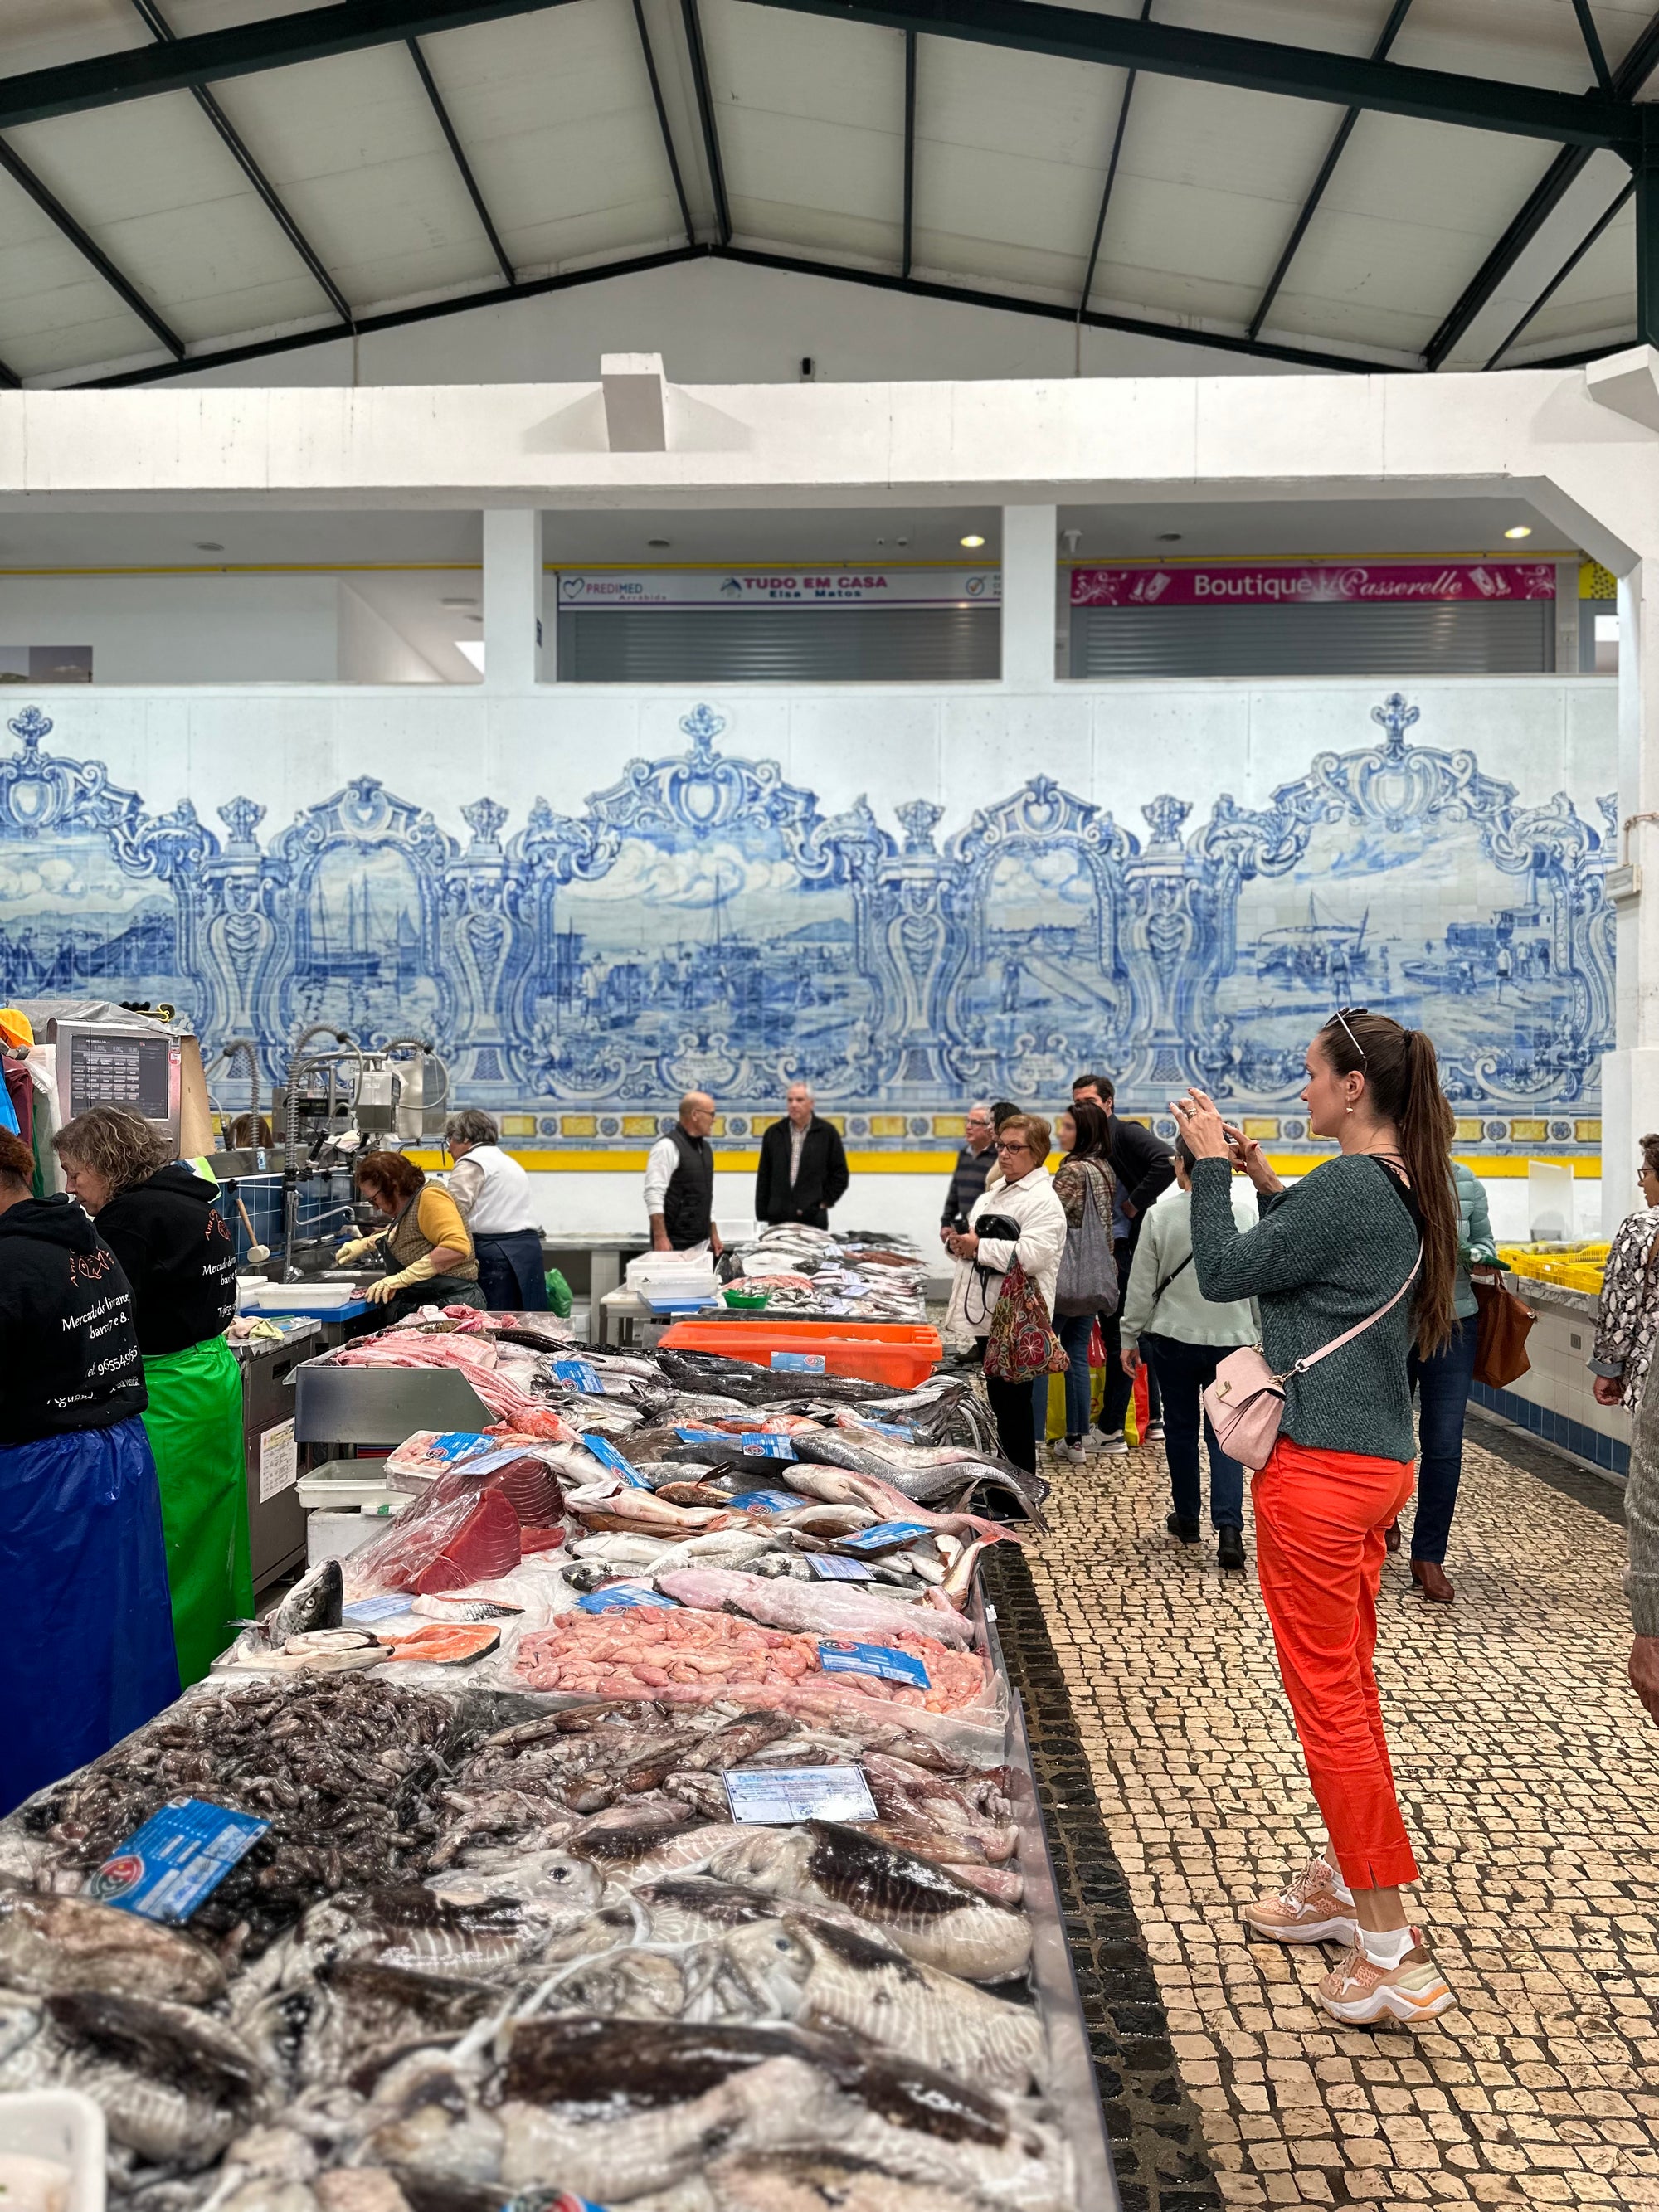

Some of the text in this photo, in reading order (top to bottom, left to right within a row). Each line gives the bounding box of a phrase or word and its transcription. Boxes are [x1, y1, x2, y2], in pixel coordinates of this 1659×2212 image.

[586, 583, 643, 594] PREDIMED
[742, 576, 888, 589] TUDO EM CASA
[1194, 567, 1462, 600] Boutique Passerelle
[105, 1291, 131, 1310] livrame
[114, 1317, 119, 1325] e
[119, 1312, 130, 1323] 8.
[87, 1362, 96, 1377] el.
